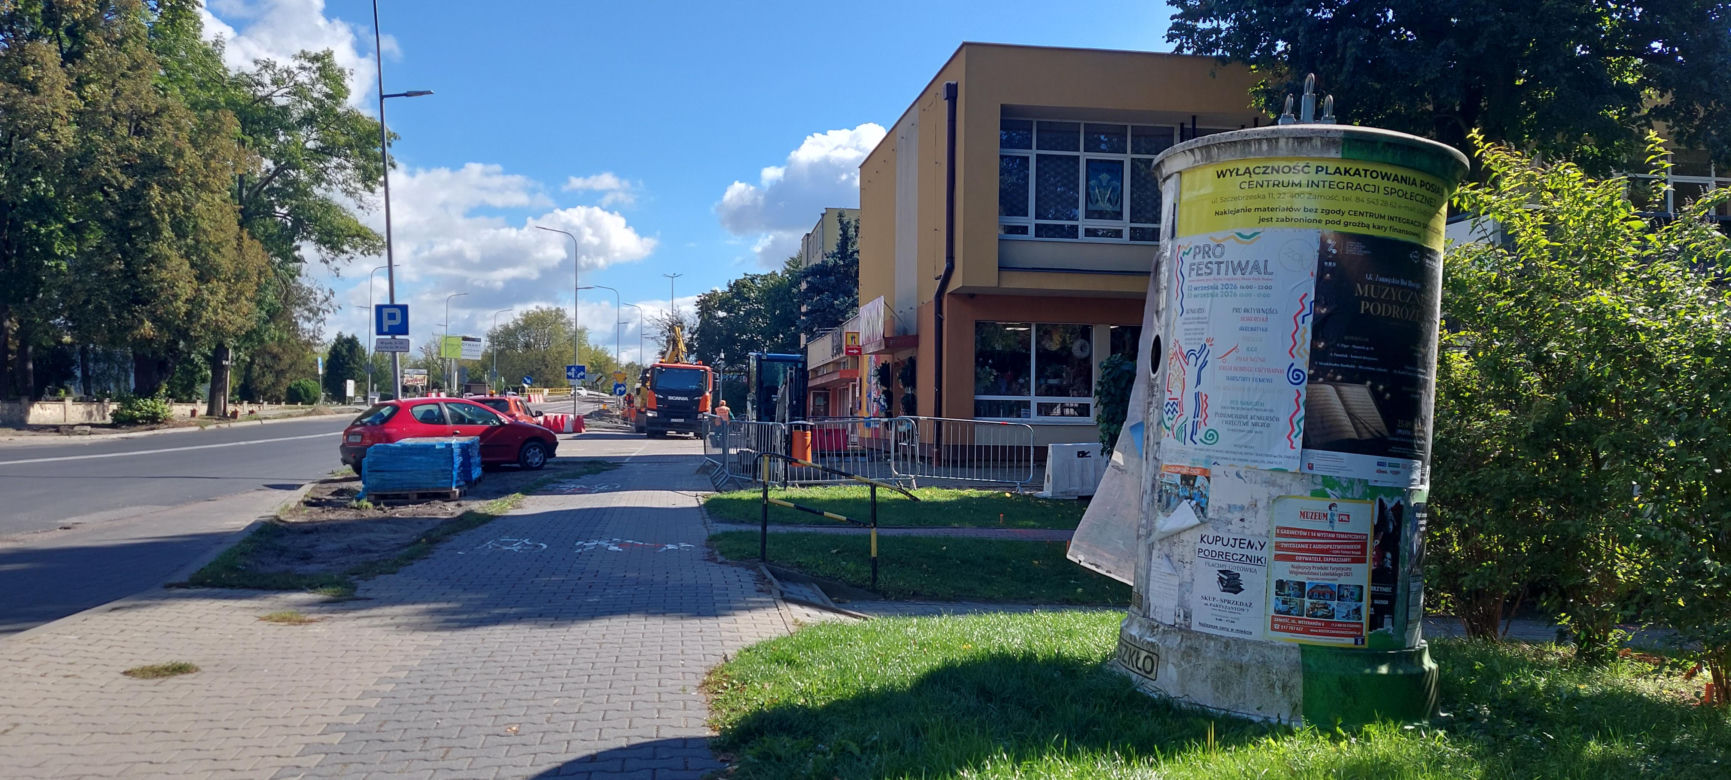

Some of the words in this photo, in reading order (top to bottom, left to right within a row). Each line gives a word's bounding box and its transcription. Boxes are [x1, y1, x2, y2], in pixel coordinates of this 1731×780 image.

[1216, 162, 1311, 178] WYŁĄCZNOŚĆ
[1315, 165, 1417, 188] PLAKATOWANIA
[1239, 180, 1302, 190] CENTRUM
[1306, 179, 1380, 194] INTEGRACJI
[1214, 205, 1252, 216] Naklejanie
[1254, 205, 1301, 213] materiałów
[1303, 206, 1318, 214] bez
[1320, 208, 1345, 217] zgody
[1348, 210, 1386, 220] CENTRUM
[1258, 216, 1273, 224] jest
[1275, 216, 1323, 224] zabronione
[1372, 223, 1387, 232] kary
[1193, 243, 1226, 259] PRO
[1188, 260, 1274, 278] FESTIWAL
[382, 308, 401, 332] P
[1299, 510, 1328, 520] MUZEUM
